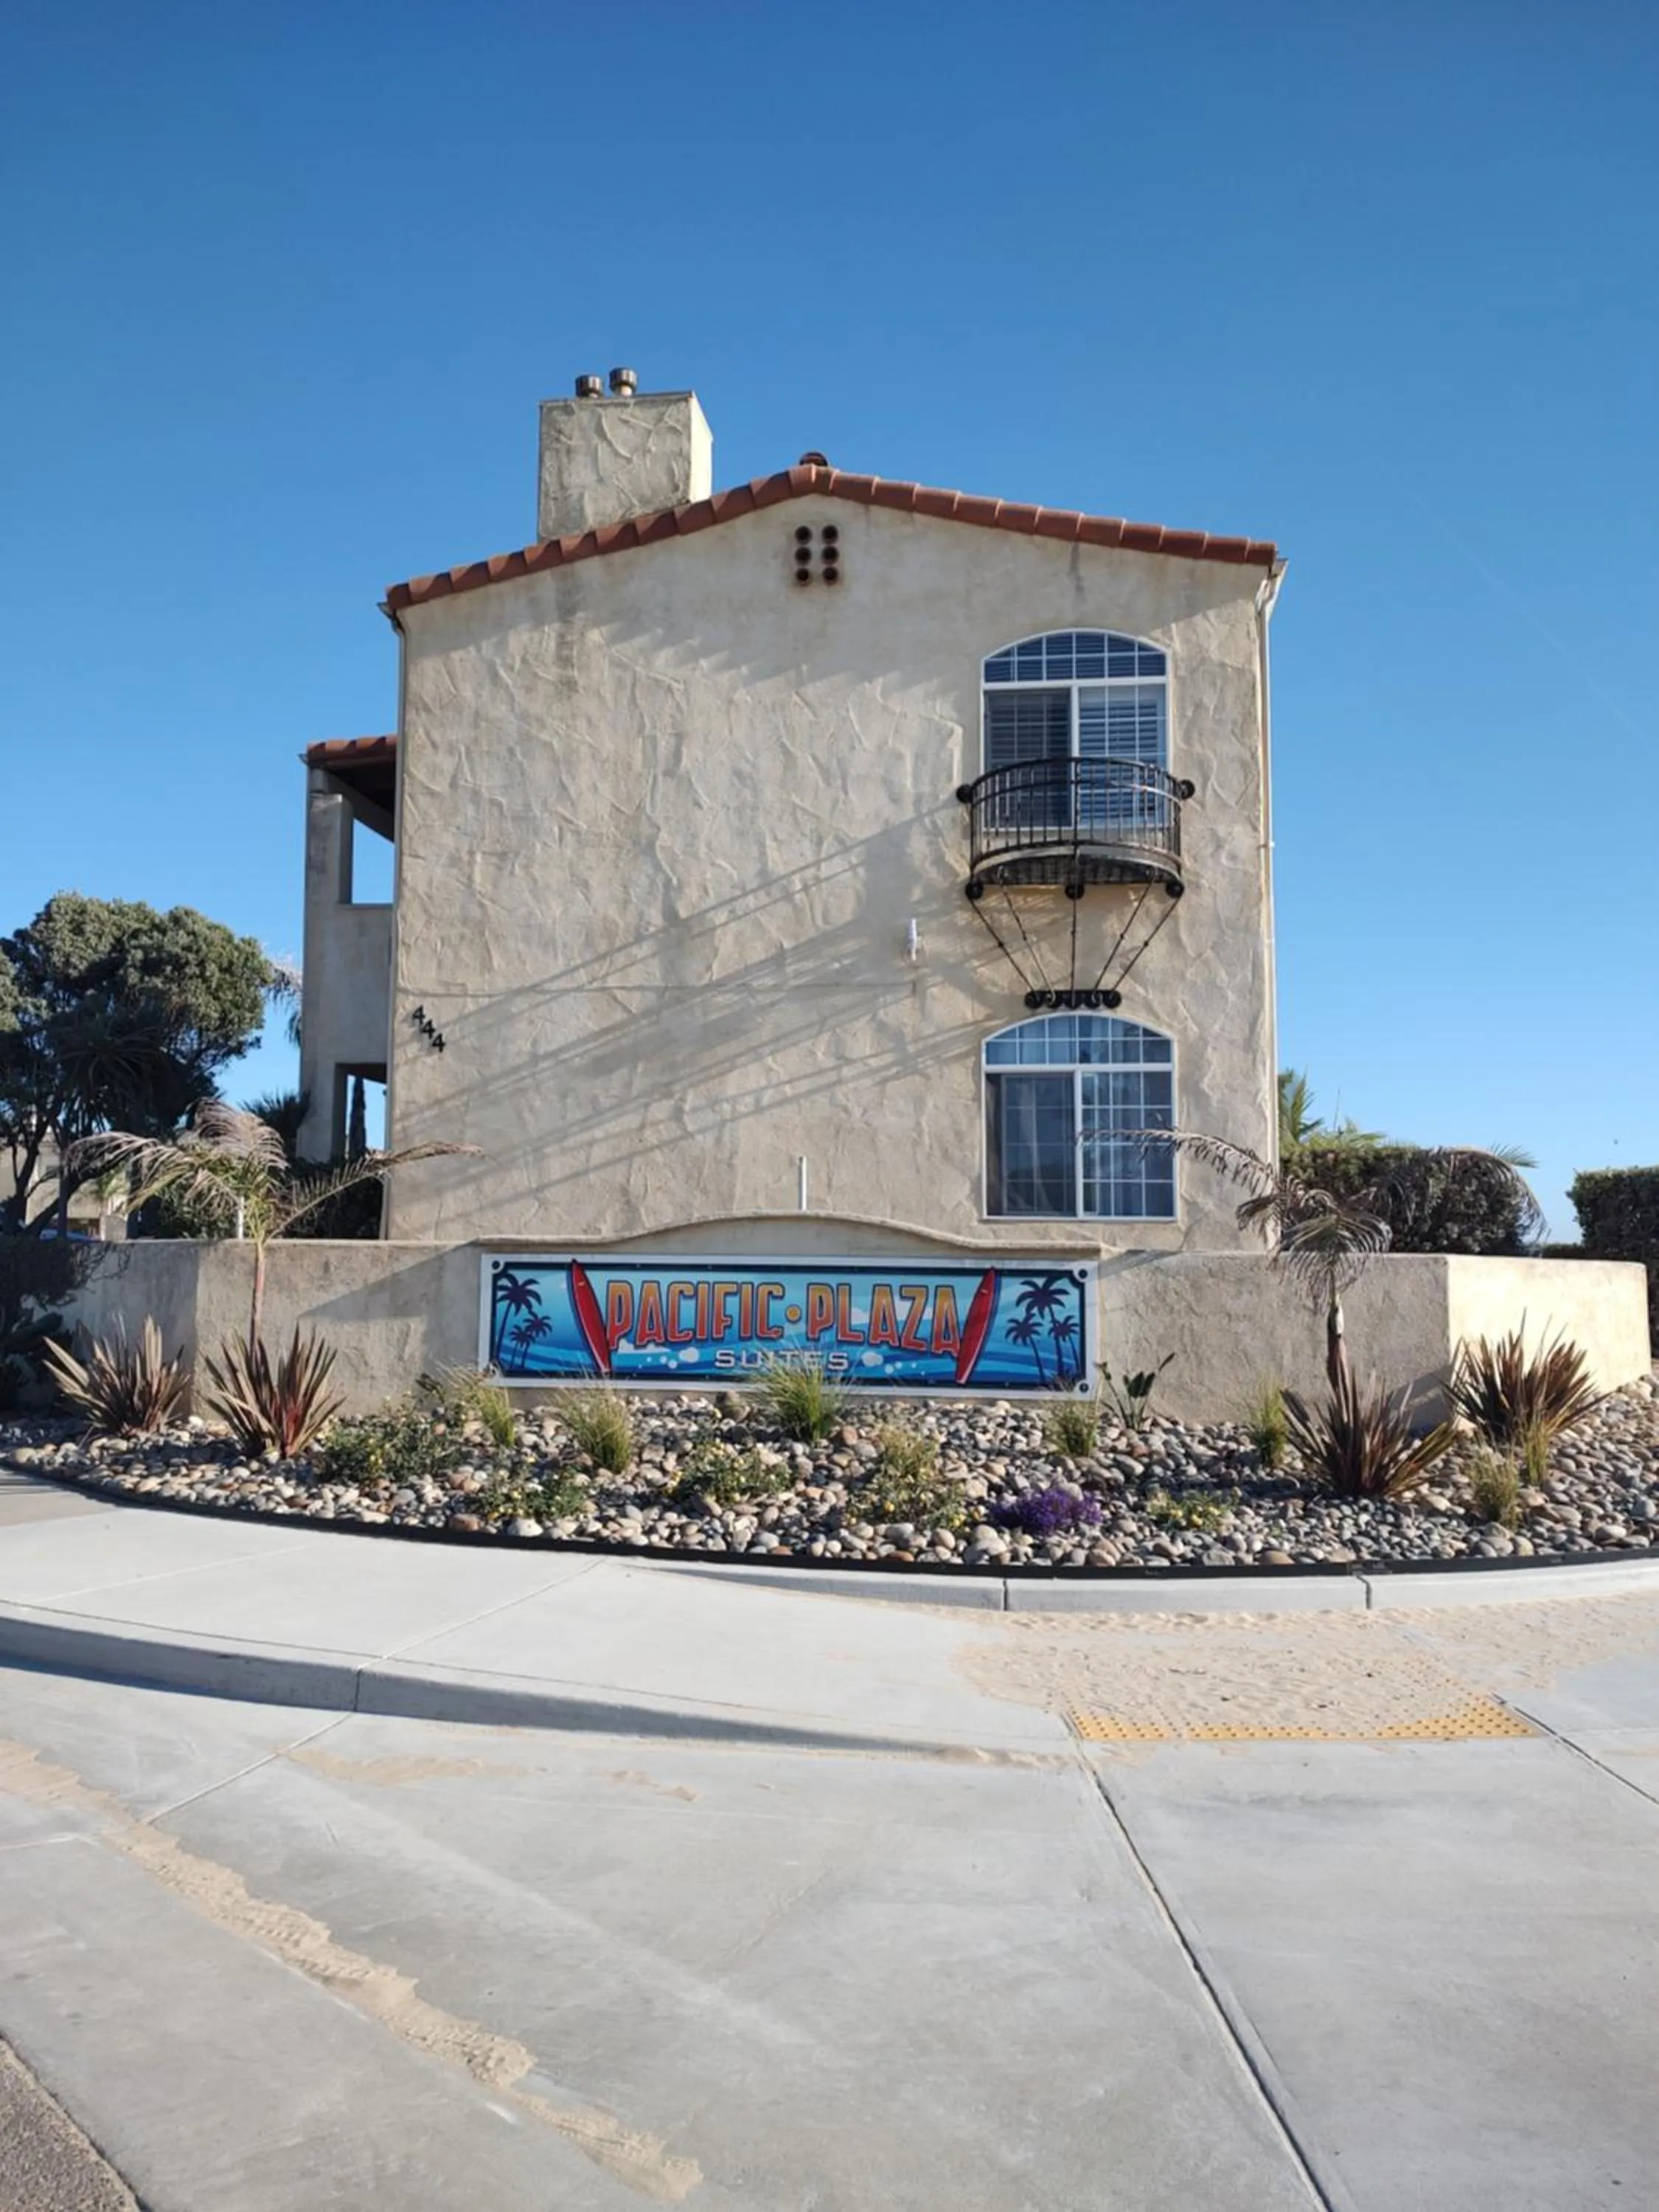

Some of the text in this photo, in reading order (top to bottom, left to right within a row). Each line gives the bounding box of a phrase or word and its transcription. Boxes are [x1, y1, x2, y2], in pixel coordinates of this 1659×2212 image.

[412, 1004, 445, 1053] 444
[606, 1280, 960, 1357] PACIFIC PLAZA
[714, 1350, 848, 1370] SUITES
